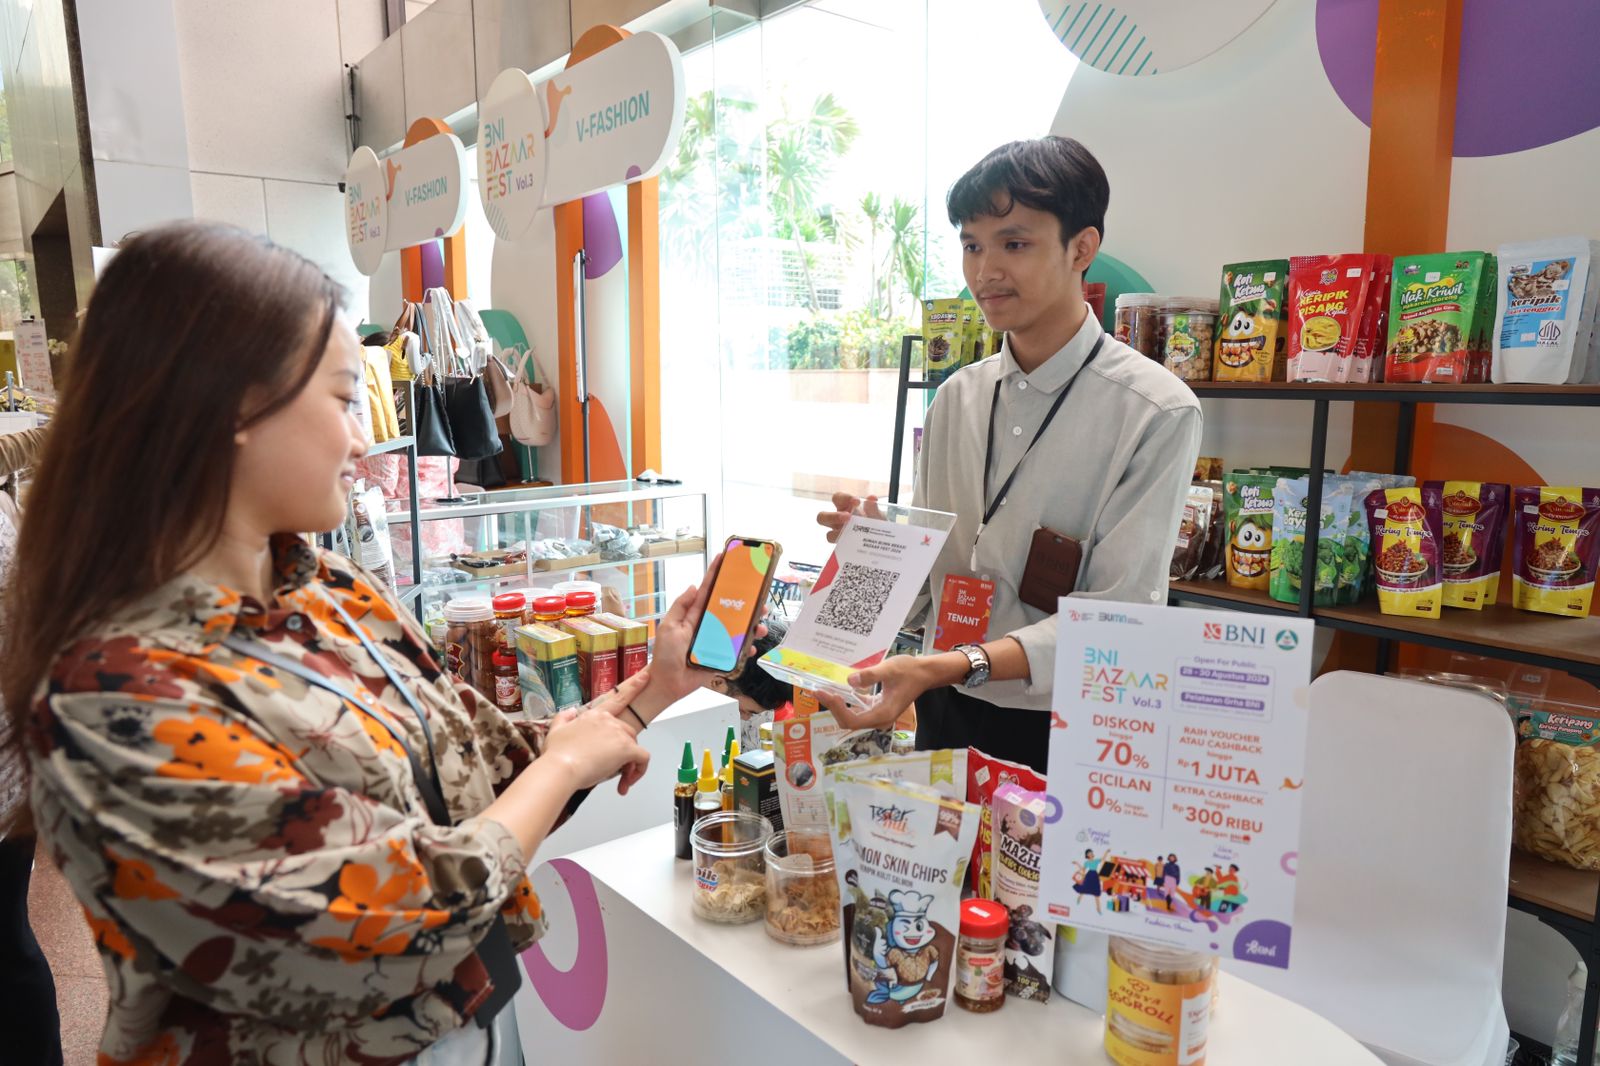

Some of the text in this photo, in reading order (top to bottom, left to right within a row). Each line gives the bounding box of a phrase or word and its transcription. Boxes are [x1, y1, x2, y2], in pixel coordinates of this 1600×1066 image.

[576, 91, 650, 142] V-FASHION
[484, 117, 505, 148] BNI
[486, 133, 535, 174] BAZAAR
[405, 176, 448, 207] V-FASHION
[487, 171, 533, 201] FEST Vol.3
[1300, 290, 1350, 306] KERIPIK
[1401, 283, 1464, 305] Mak Kriwil
[1300, 301, 1344, 316] PISANG
[1240, 485, 1260, 498] Roti
[1243, 497, 1274, 509] Ketawa
[1375, 525, 1432, 538] Kering Tempe
[1458, 520, 1485, 533] Tempe
[1527, 521, 1590, 537] Kering Tempe
[947, 612, 980, 627] TENANT
[1226, 624, 1265, 645] BNI
[1084, 647, 1118, 667] BNI
[1194, 656, 1256, 669] Open For Public
[1083, 665, 1169, 691] BAZAAR
[1211, 670, 1245, 681] Agustus
[1081, 683, 1162, 709] FEST Vol.3
[1093, 714, 1155, 734] DISKON
[1548, 713, 1593, 729] Keripang
[1179, 737, 1263, 754] ATAU CASHBACK
[1184, 727, 1261, 744] RAIH VOUCHER
[1096, 739, 1149, 770] 70%
[1088, 771, 1152, 792] CICILAN
[1178, 759, 1260, 785] Rp 1 JUTA
[1088, 786, 1122, 814] 0%
[1174, 785, 1264, 806] EXTRA CASHBACK
[1172, 803, 1264, 834] Rp 300 RIBU
[1001, 836, 1041, 869] MAZH
[883, 854, 910, 877] SKIN
[911, 862, 948, 883] CHIPS
